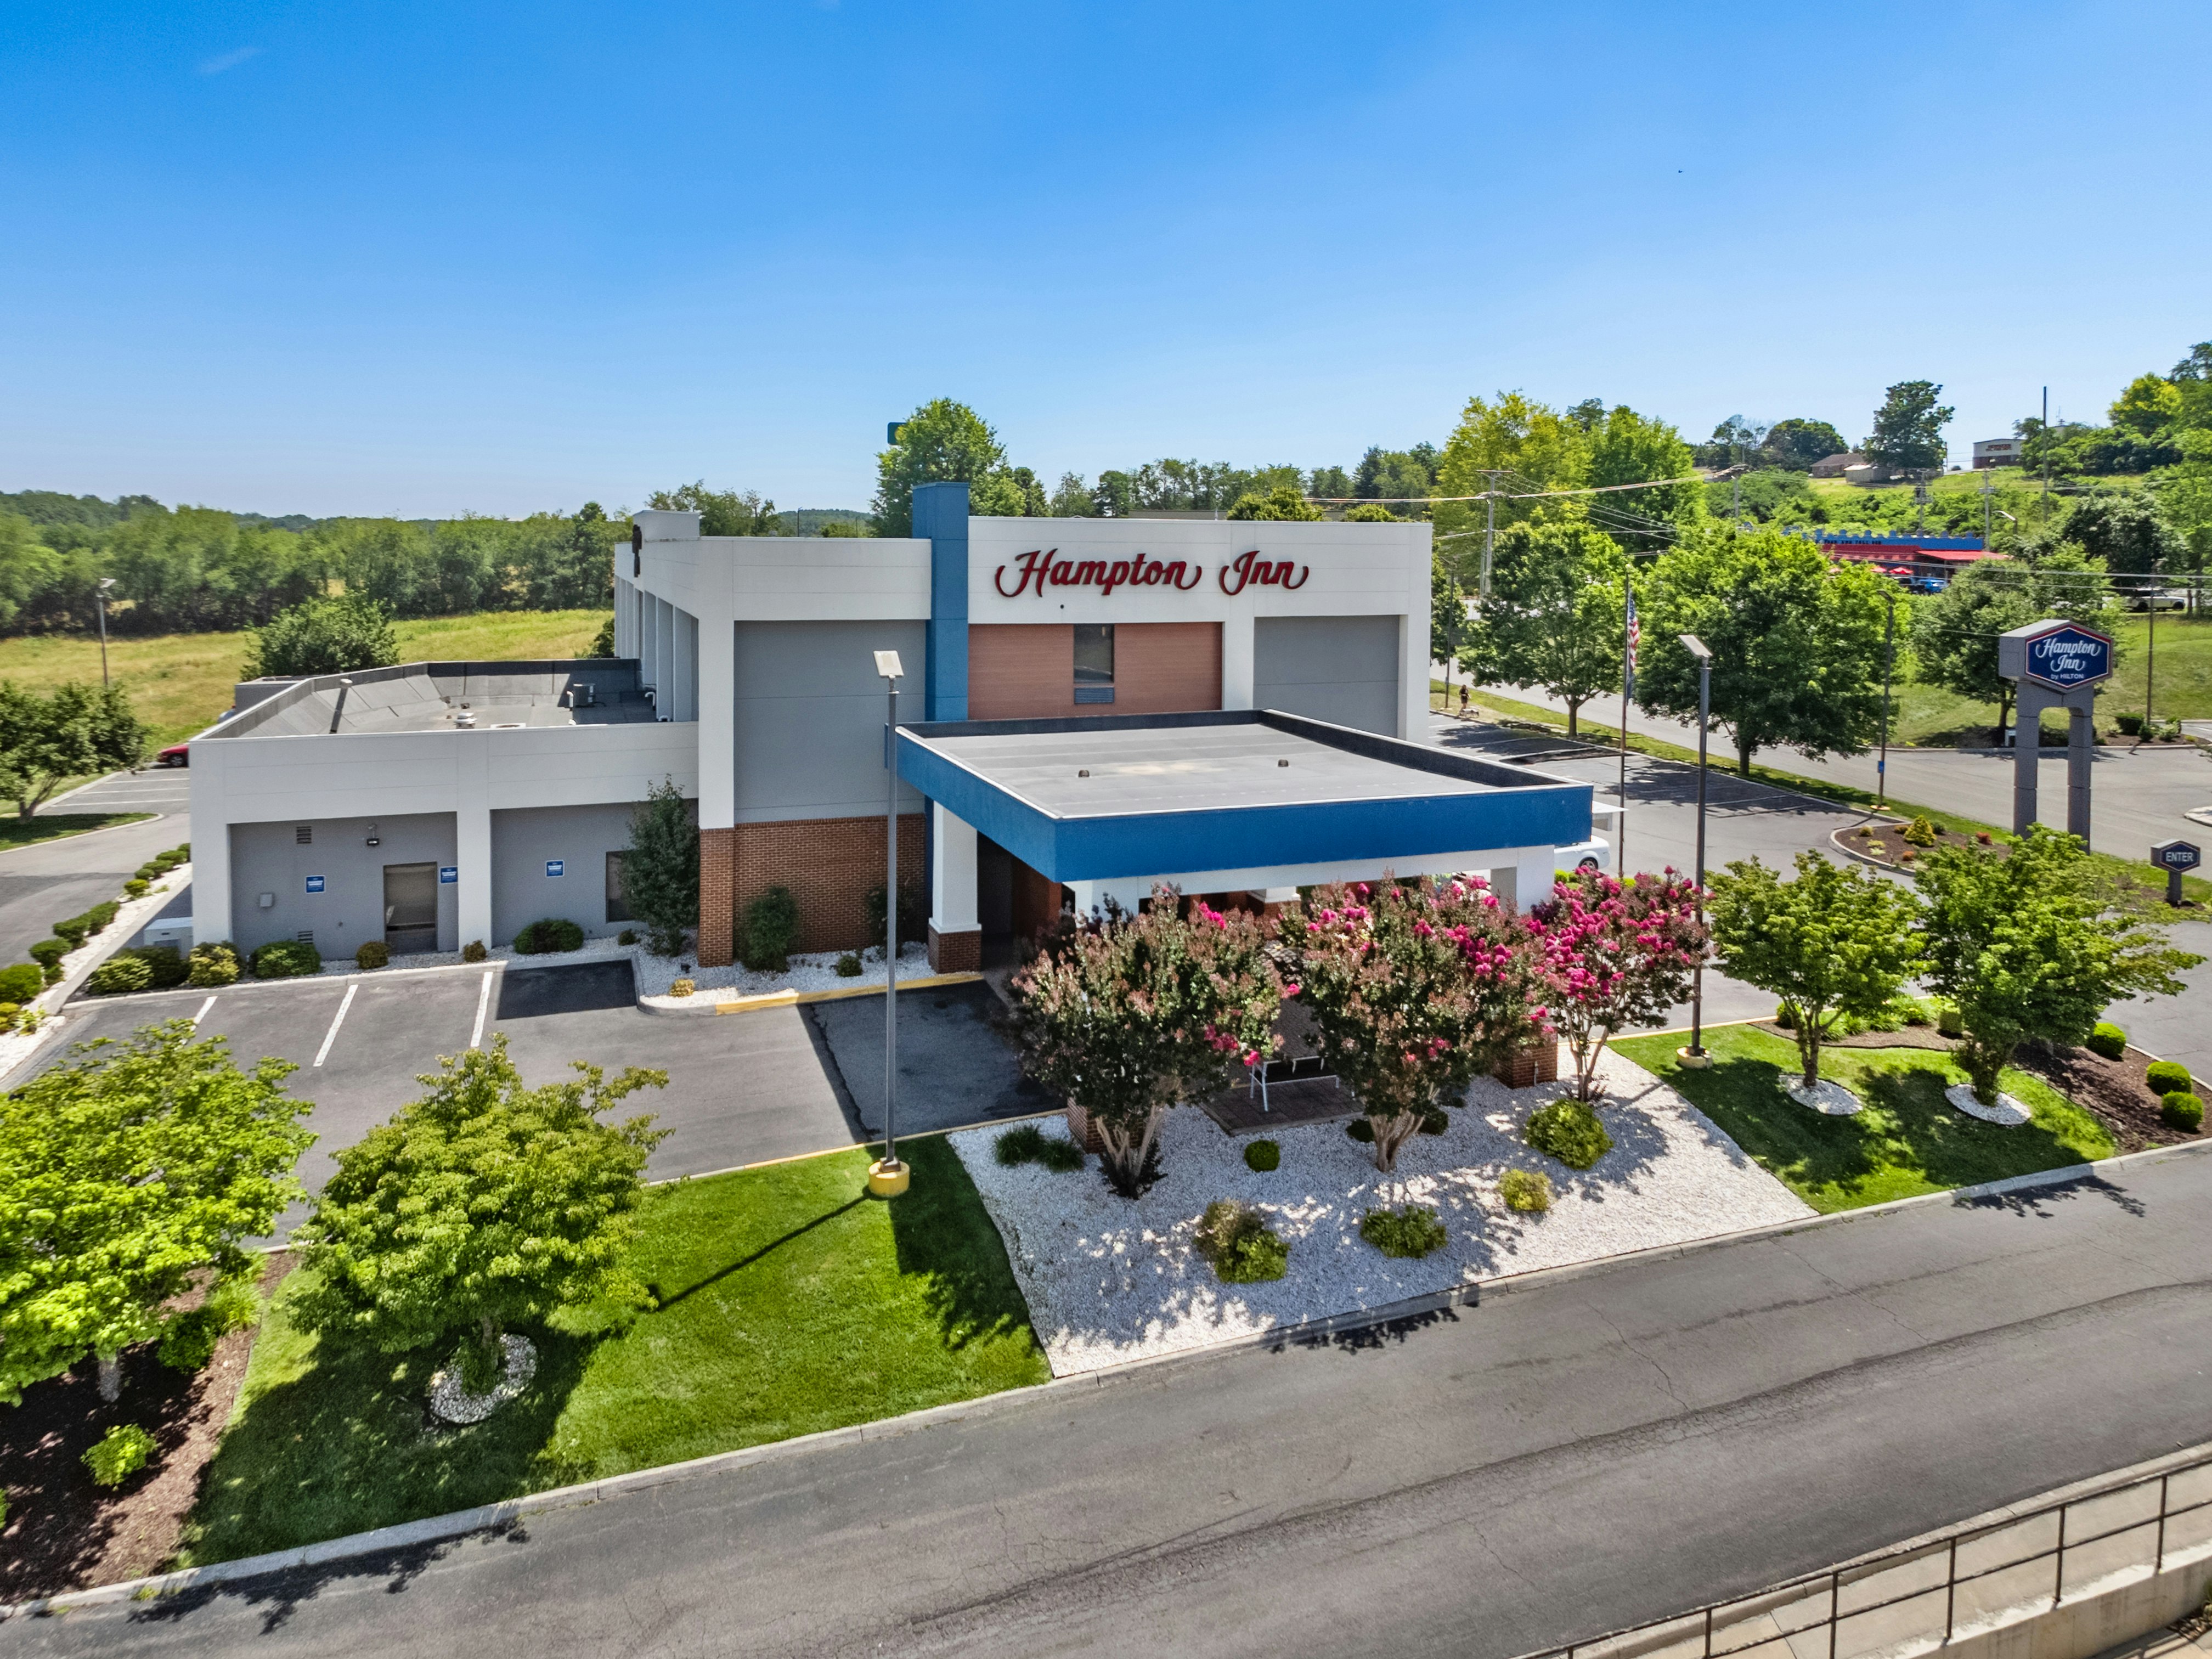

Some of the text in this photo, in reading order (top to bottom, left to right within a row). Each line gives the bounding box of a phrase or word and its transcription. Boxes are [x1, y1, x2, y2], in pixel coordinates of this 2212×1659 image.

[994, 548, 1309, 597] Hampton Inn
[2035, 637, 2101, 658] Hampton
[2050, 654, 2086, 672] Inn
[2166, 851, 2193, 862] ENTER
